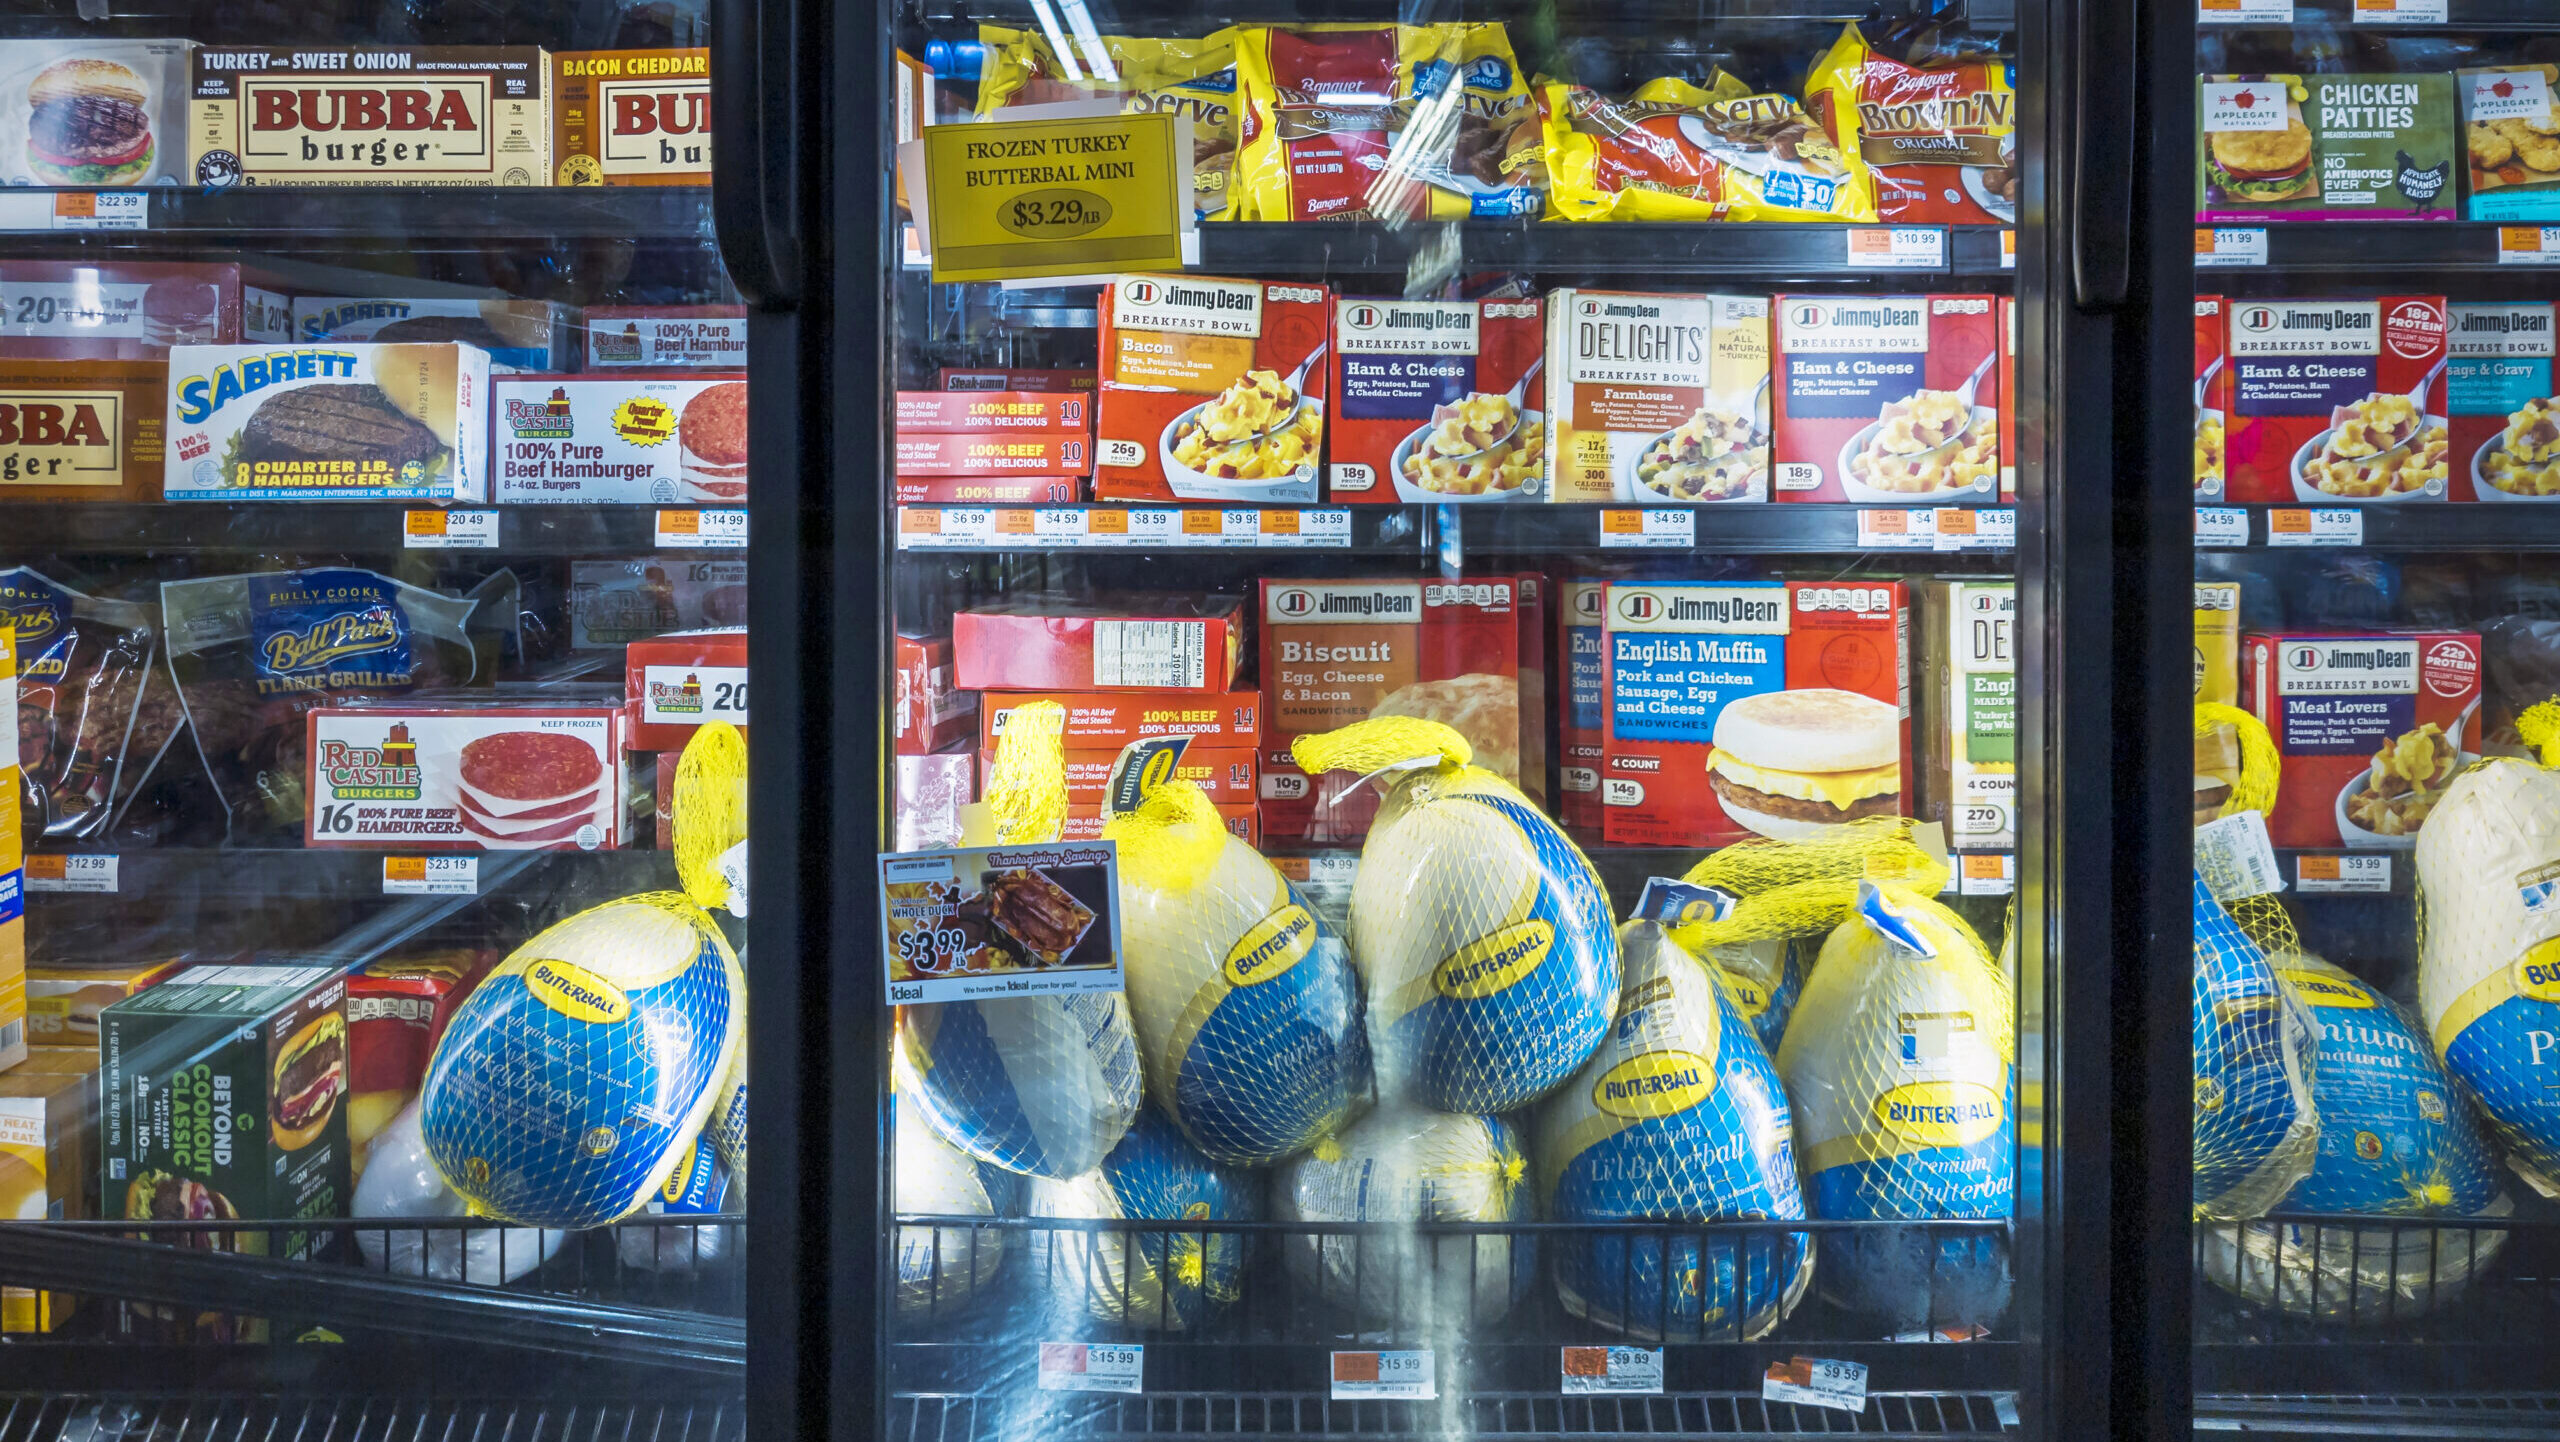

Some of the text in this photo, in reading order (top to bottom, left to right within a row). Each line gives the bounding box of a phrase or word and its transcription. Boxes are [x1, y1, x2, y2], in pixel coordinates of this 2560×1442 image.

[204, 52, 411, 69] TURKEY with SWEET ONION
[563, 57, 705, 76] BACON CHEDDAR
[506, 79, 526, 87] REAL
[1301, 78, 1366, 93] Banquet
[2321, 85, 2418, 104] CHICKEN
[252, 89, 477, 131] BUBBA
[2472, 99, 2539, 109] APPLEGATE
[2322, 108, 2413, 128] PATTIES
[967, 134, 1131, 159] FROZEN TURKEY
[1894, 136, 1968, 150] ORIGINAL
[302, 136, 430, 166] burger
[2325, 158, 2345, 168] NO
[966, 162, 1135, 187] BUTTERBAL MINI
[2325, 170, 2392, 179] ANTIBIOTICS
[2324, 180, 2359, 189] EVER
[1308, 197, 1349, 212] Banquet
[1123, 315, 1252, 332] BREAKFAST BOWL
[1386, 309, 1471, 330] Jimmy Dean
[2388, 319, 2443, 332] PROTEIN
[655, 324, 729, 337] 100% Pure
[1123, 339, 1173, 355] Bacon
[1347, 340, 1470, 350] BREAKFAST BOWL
[1580, 322, 1702, 363] DELIGHTS
[1792, 338, 1919, 348] BREAKFAST BOWL
[2241, 341, 2371, 351] BREAKFAST BOWL
[1348, 363, 1465, 376] Ham & Cheese
[1792, 362, 1914, 374] Ham & Cheese
[2242, 365, 2366, 378] Ham & Cheese
[1580, 370, 1700, 383] BREAKFAST BOWL
[177, 350, 357, 424] SABRETT
[1604, 389, 1673, 401] Farmhouse
[968, 401, 1080, 420] 100% BEEF 10
[965, 417, 1047, 426] 100% DELICIOUS
[179, 443, 211, 461] BEEF
[504, 443, 603, 459] 100% Pure
[968, 442, 1081, 460] 100% BEEF 10
[964, 458, 1048, 468] 100% DELICIOUS
[236, 461, 393, 486] 8 QUARTER LB.
[505, 462, 654, 480] Beef Hamburger
[254, 474, 392, 486] HAMBURGERS
[249, 489, 266, 497] DIST.
[430, 488, 452, 496] 10454
[1668, 597, 1777, 624] Jimmy Dean
[267, 613, 398, 670] Ball Park
[1282, 642, 1391, 662] Biscuit
[1617, 641, 1767, 665] English Muffin
[2328, 650, 2411, 670] Jimmy Dean
[2426, 657, 2476, 670] PROTEIN
[1282, 671, 1384, 685] Egg, Cheese
[1617, 669, 1754, 685] Pork and Chicken
[2287, 681, 2411, 690] BREAKFAST BOWL
[1283, 690, 1351, 701] & Bacon
[1617, 686, 1717, 702] Sausage, Egg
[1283, 707, 1368, 715] SANDWICHES
[1617, 702, 1705, 715] and Cheese
[2289, 701, 2387, 713] Meat Lovers
[1143, 711, 1217, 722] 100% BEEF
[1234, 708, 1253, 725] 14
[1617, 719, 1708, 729] SANDWICHES
[1139, 724, 1220, 734] 100% DELICIOUS
[330, 767, 419, 786] CASTLE
[1177, 767, 1213, 778] BEEF
[1229, 764, 1249, 781] 14
[338, 788, 416, 798] BURGERS
[319, 804, 356, 833] 16
[357, 809, 456, 818] 100% PURE BEEF
[1967, 810, 1996, 821] 270
[356, 821, 464, 834] HAMBURGERS
[988, 850, 1110, 868] Thanksgiving Savings
[891, 905, 954, 918] WHOLE DUCK
[1234, 914, 1311, 976] BUTTERBALL
[1445, 932, 1545, 988] BUTTERBALL
[536, 966, 618, 1015] BUTTERBALL
[891, 986, 923, 1000] ideal
[1007, 981, 1029, 990] ideal
[1062, 981, 1077, 989] you!
[1605, 1069, 1702, 1101] BUTTERBALL
[173, 1071, 190, 1167] CLASSIC
[193, 1064, 211, 1176] COOKOUT
[1890, 1101, 1995, 1124] BUTTERBALL
[214, 1075, 232, 1166] BEYOND
[1906, 1155, 1986, 1176] Premium
